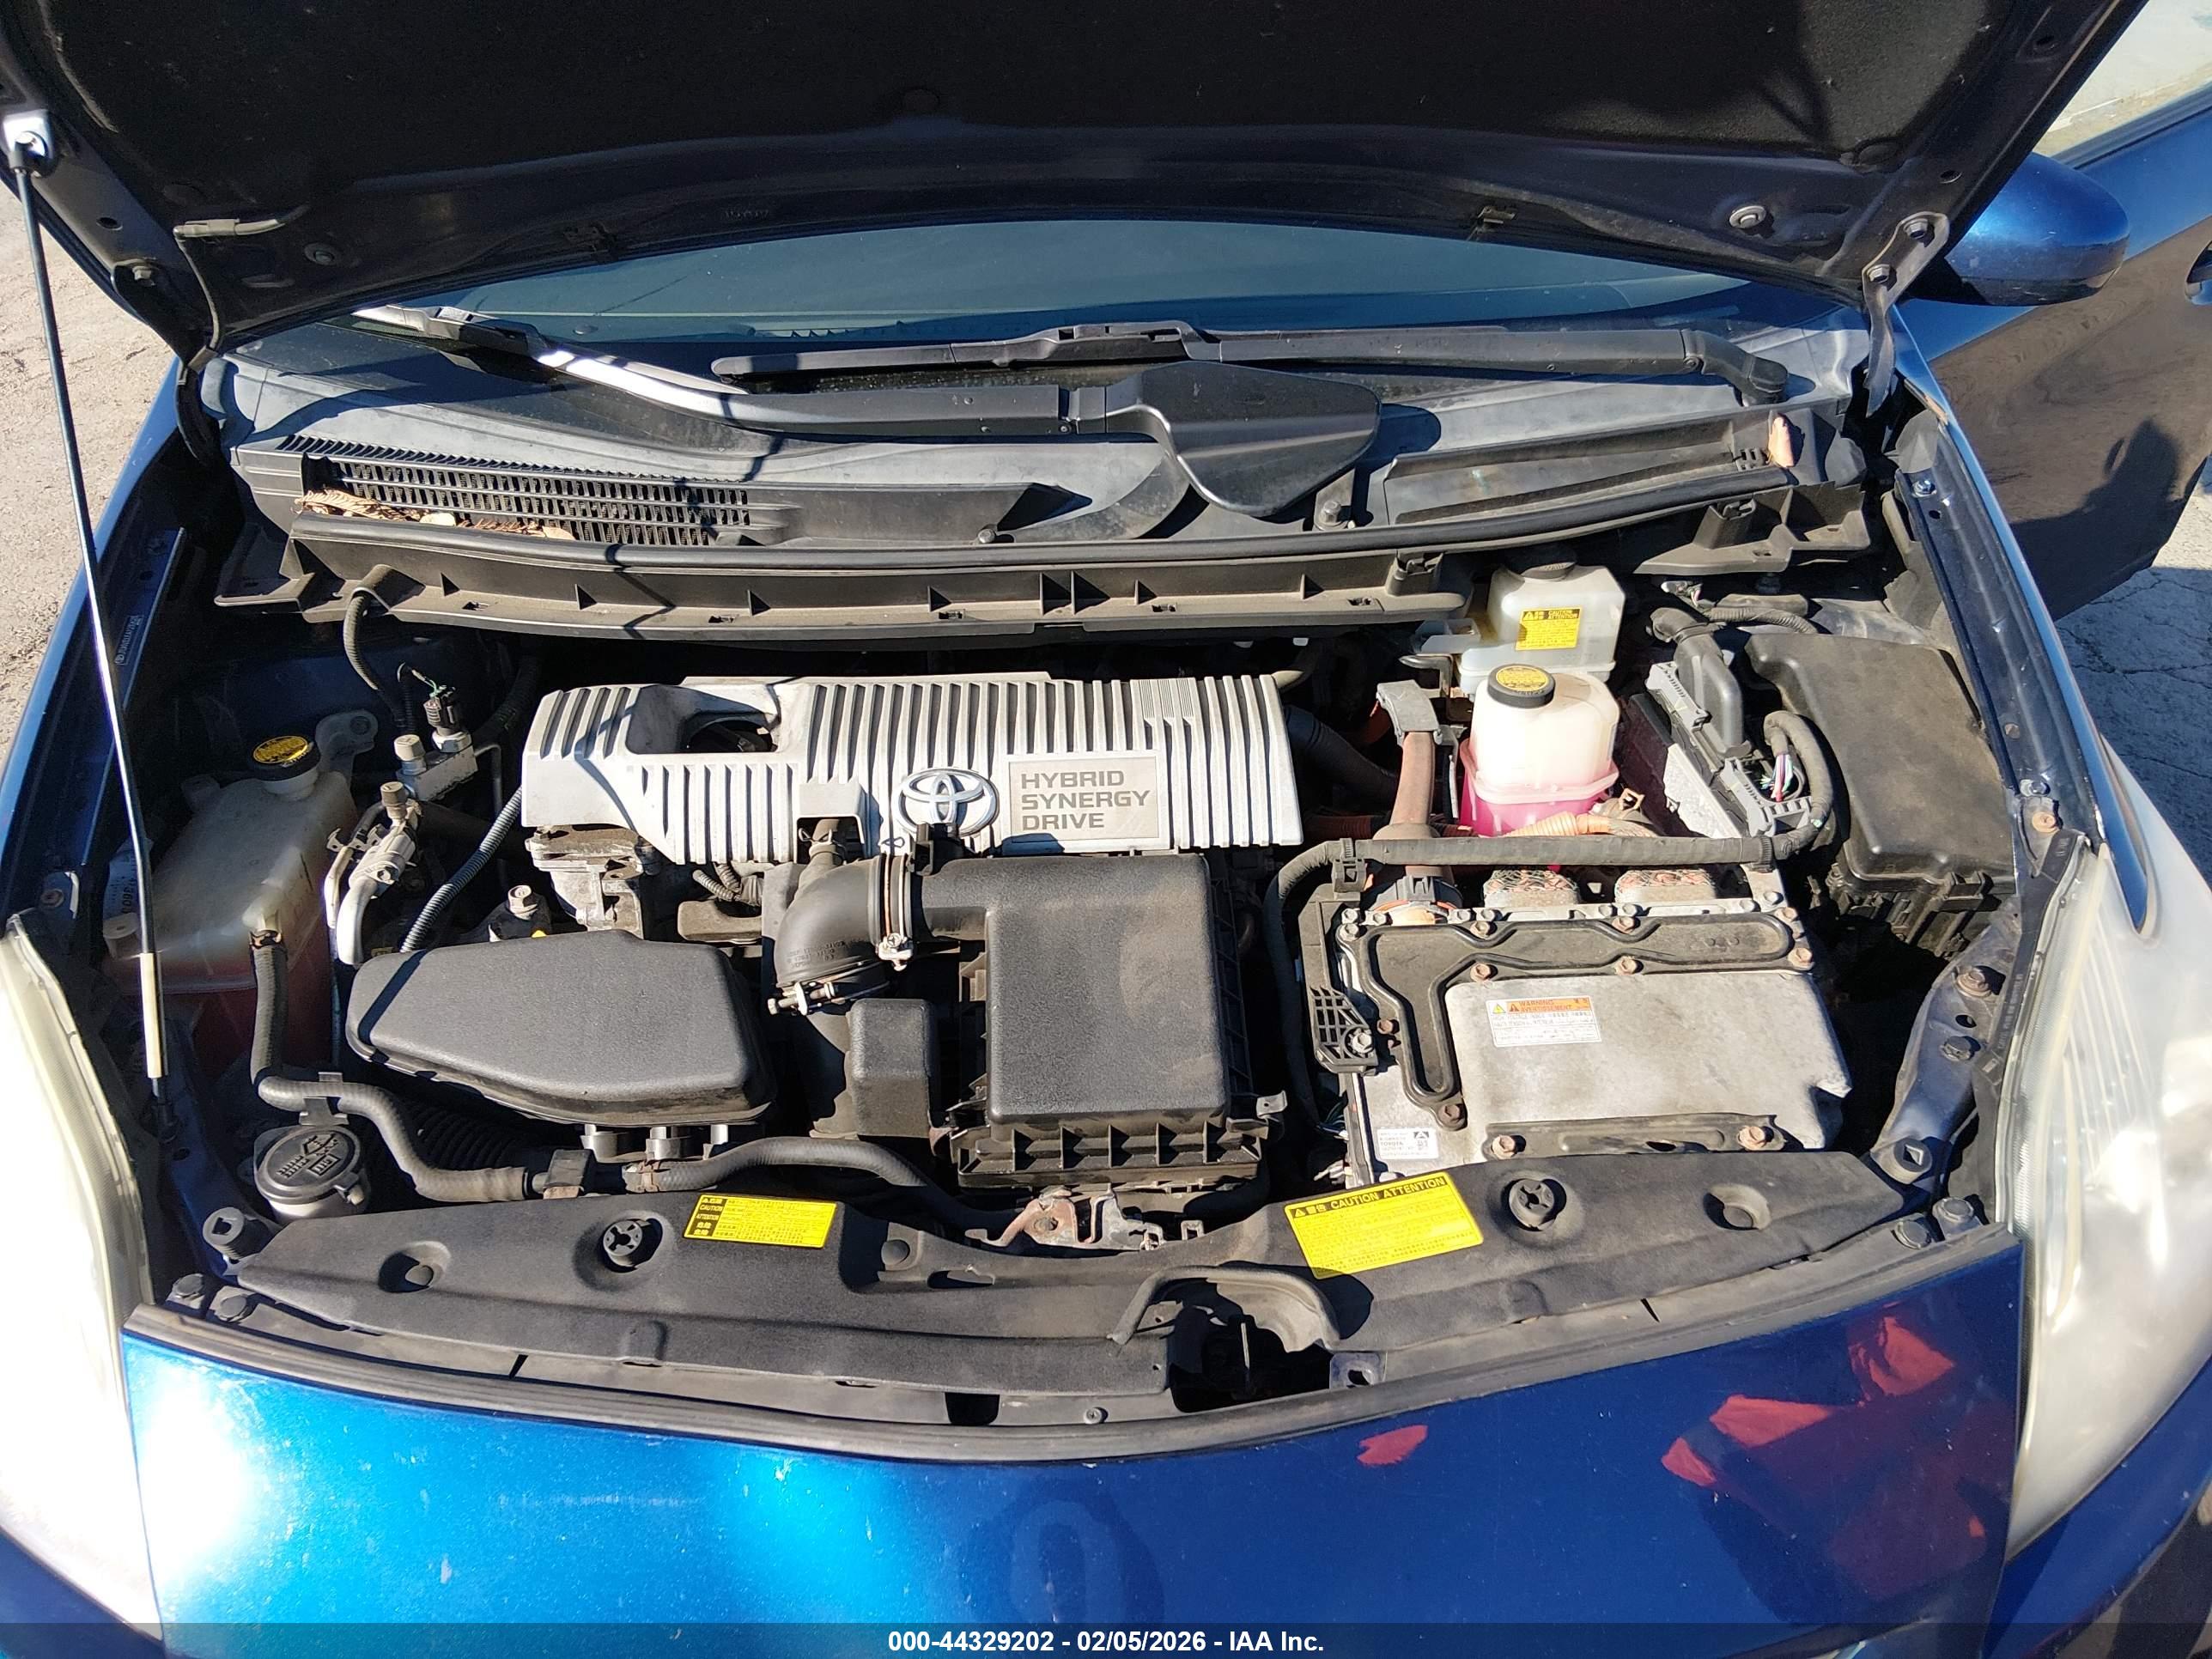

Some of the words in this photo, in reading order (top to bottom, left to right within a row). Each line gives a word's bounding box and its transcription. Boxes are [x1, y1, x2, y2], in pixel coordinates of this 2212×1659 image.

[1021, 770, 1124, 789] HYBRID
[1021, 790, 1150, 810] SYNERGY
[1023, 813, 1104, 830] DRIVE
[1331, 1192, 1380, 1210] CAUTION
[1383, 1177, 1446, 1199] ATTENTION
